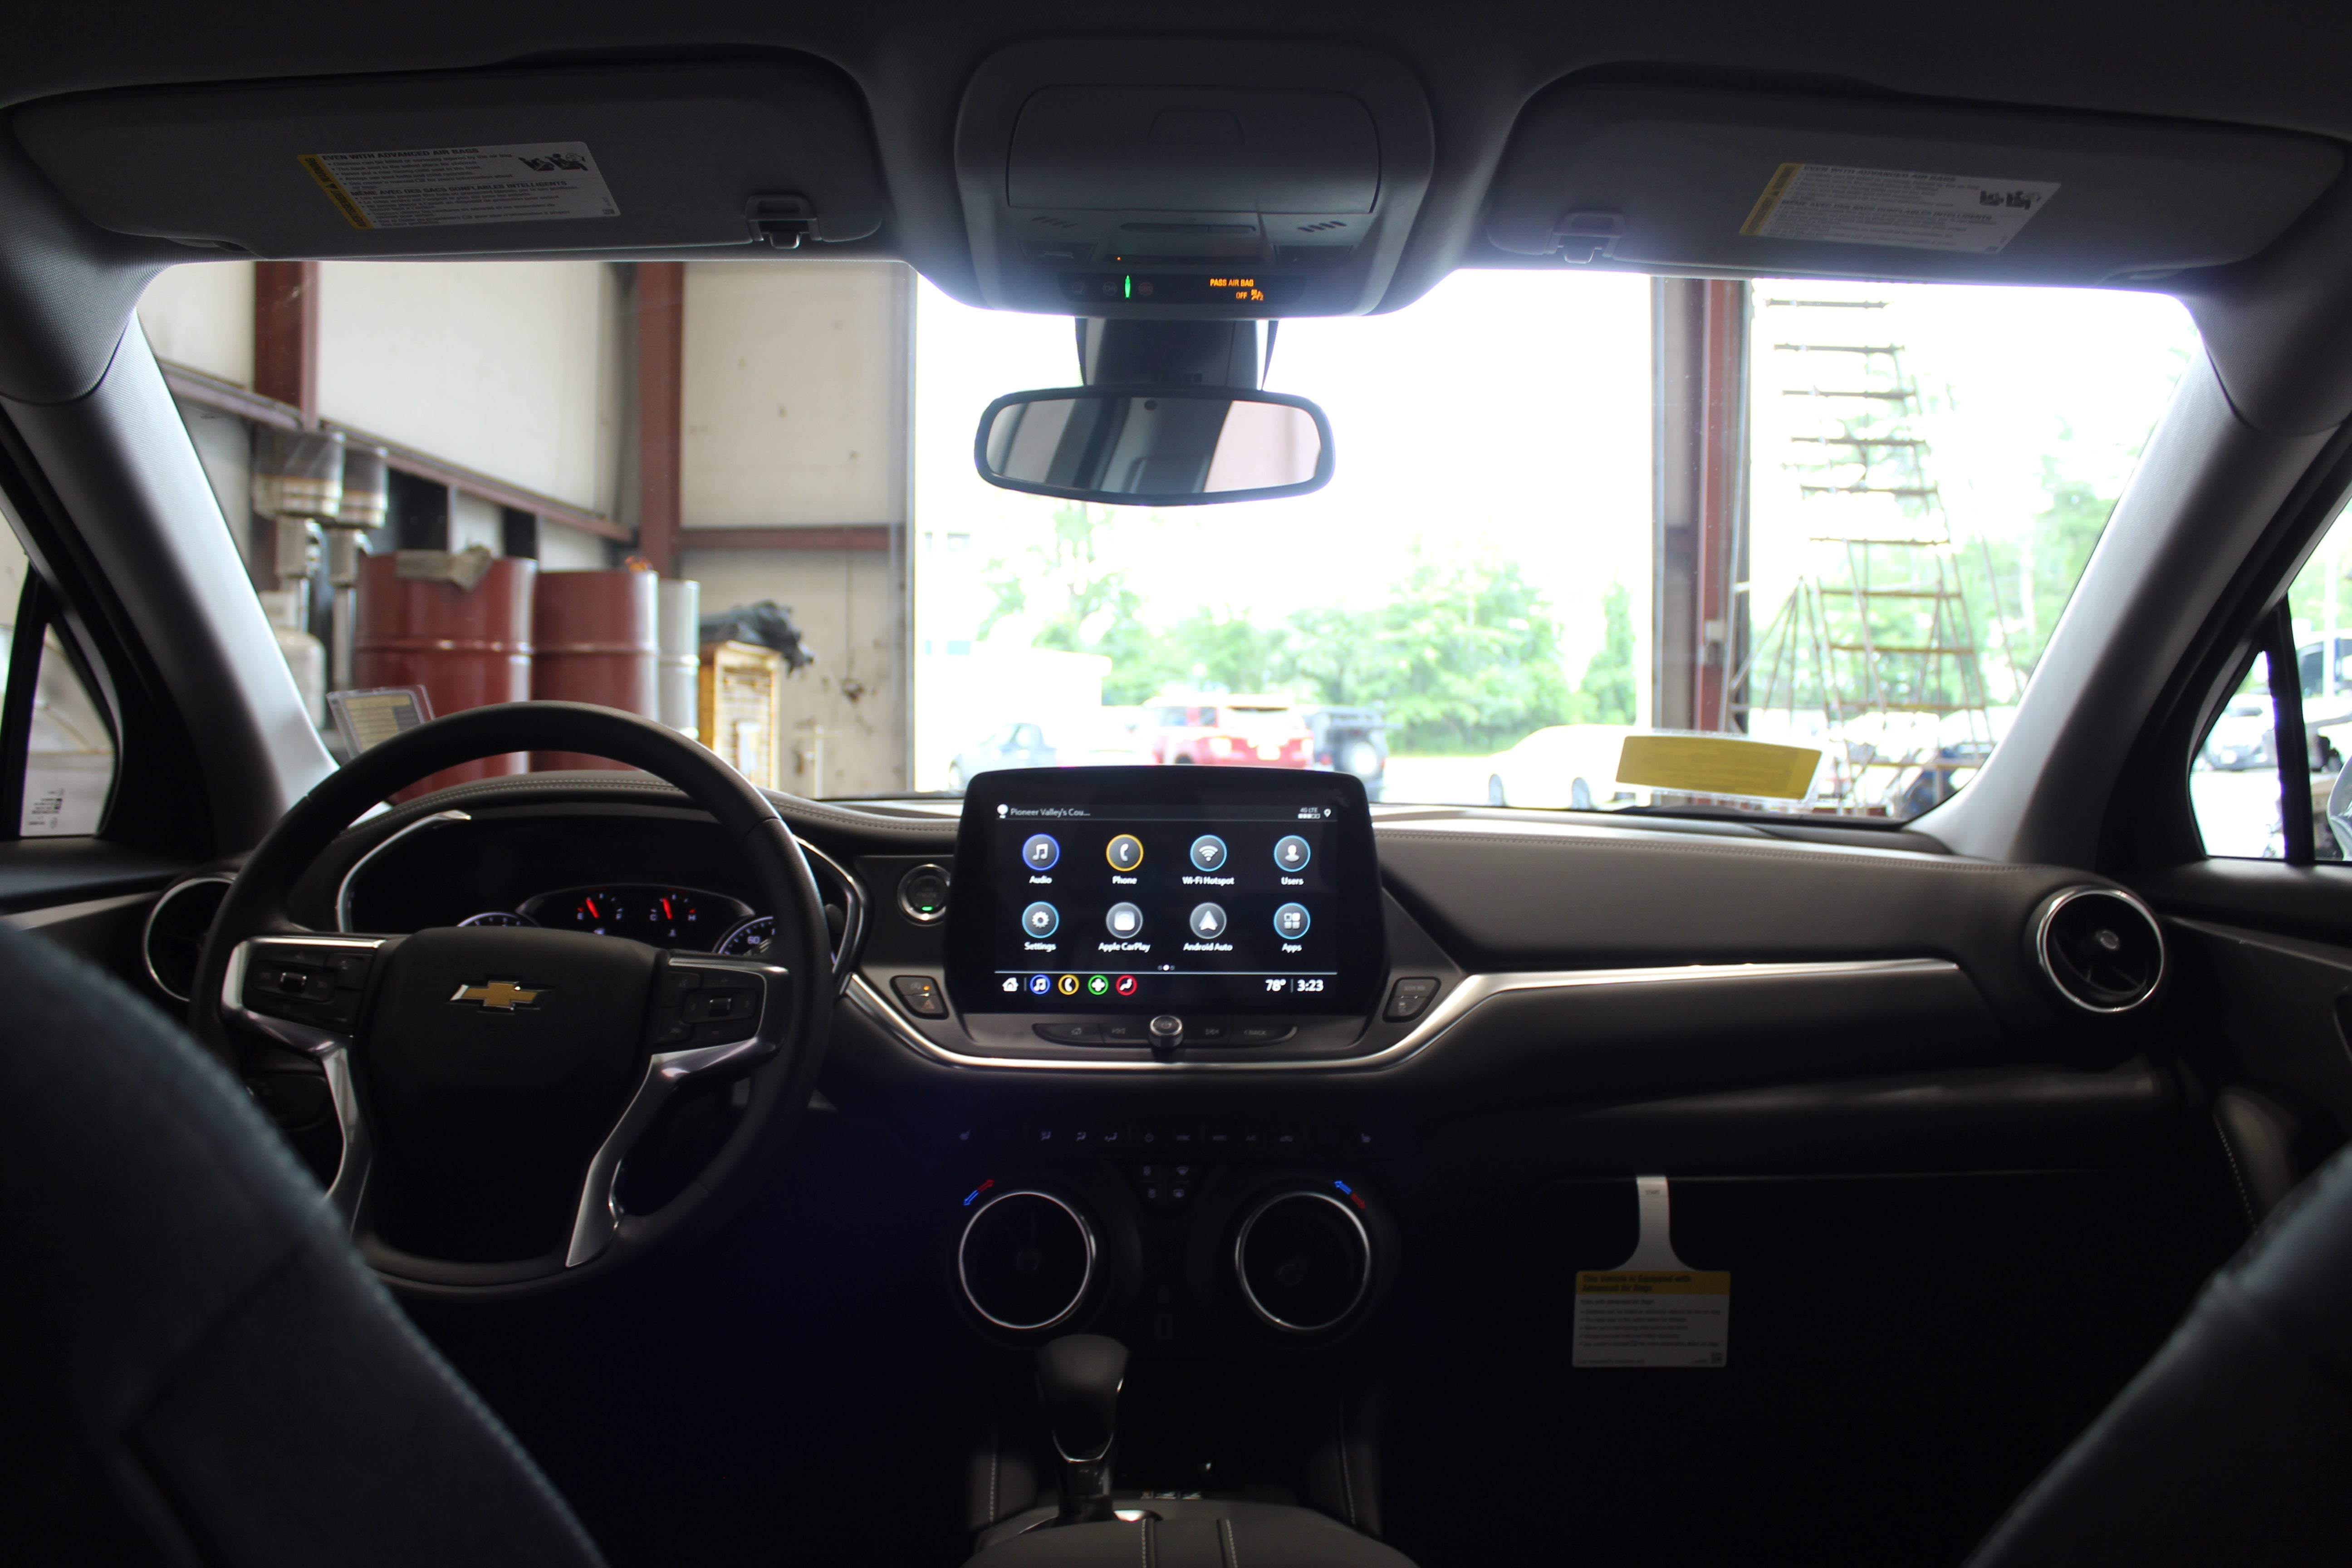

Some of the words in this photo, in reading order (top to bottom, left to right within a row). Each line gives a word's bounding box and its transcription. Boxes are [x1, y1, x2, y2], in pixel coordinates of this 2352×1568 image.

[1210, 278, 1227, 287] PASS
[1228, 279, 1240, 287] AIR
[1240, 279, 1255, 287] BAG
[1236, 291, 1248, 299] OFF
[1010, 808, 1039, 816] Pioneer
[1040, 808, 1067, 818] Valley's
[1029, 875, 1052, 884] Audio
[1112, 875, 1137, 884] Phone
[1182, 876, 1202, 885] Wi-Fi
[1203, 876, 1235, 887] Hotspot
[1281, 876, 1304, 885] Users
[1024, 941, 1056, 953] Settings
[1098, 942, 1120, 952] Apple
[1122, 942, 1151, 953] CarPlay
[1183, 942, 1212, 951] Android
[1214, 942, 1233, 951] Auto
[1282, 943, 1302, 953] Apps
[1297, 979, 1324, 992] 3:23
